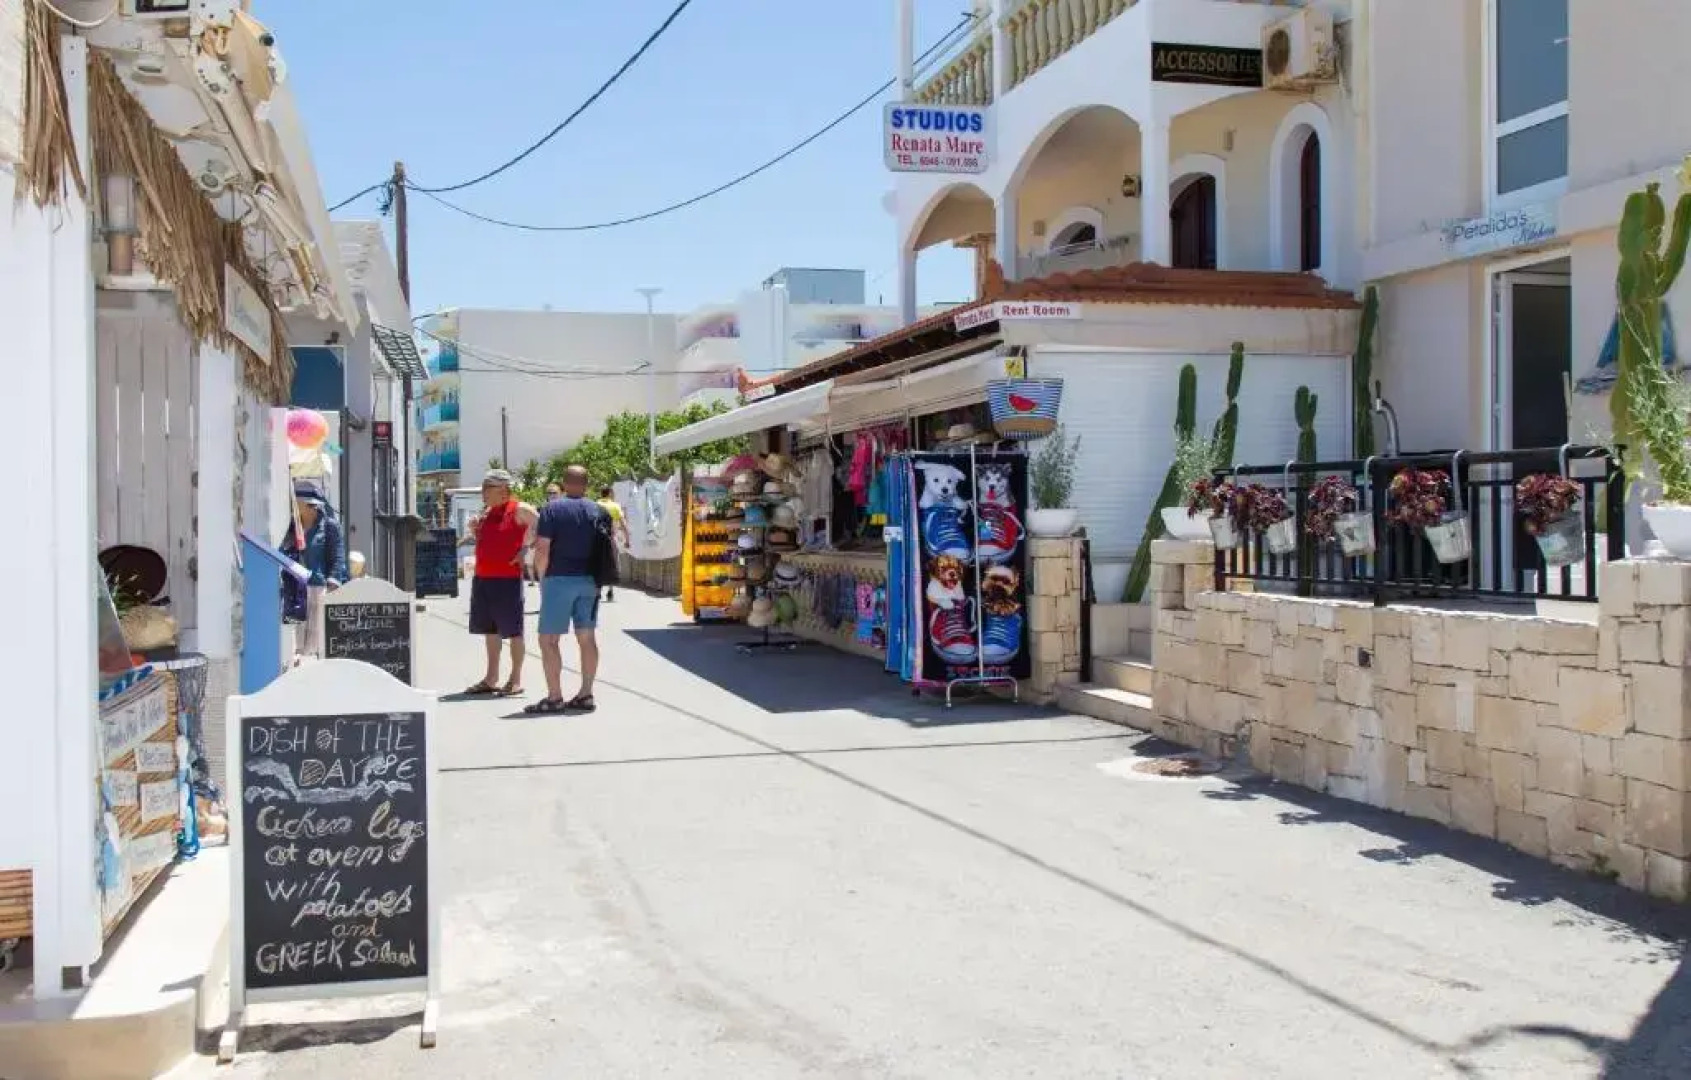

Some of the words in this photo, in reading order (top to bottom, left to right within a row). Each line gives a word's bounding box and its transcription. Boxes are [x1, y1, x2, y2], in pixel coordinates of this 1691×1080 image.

[892, 108, 982, 132] STUDIOS
[892, 133, 940, 153] Renata
[946, 136, 984, 154] Mare
[1002, 305, 1028, 316] Rent
[1033, 305, 1070, 316] Rooms
[250, 726, 308, 755] DISH
[354, 721, 416, 752] THE
[300, 756, 370, 787] DAY
[265, 870, 341, 901] with
[331, 917, 383, 938] and
[256, 939, 345, 974] GREEK
